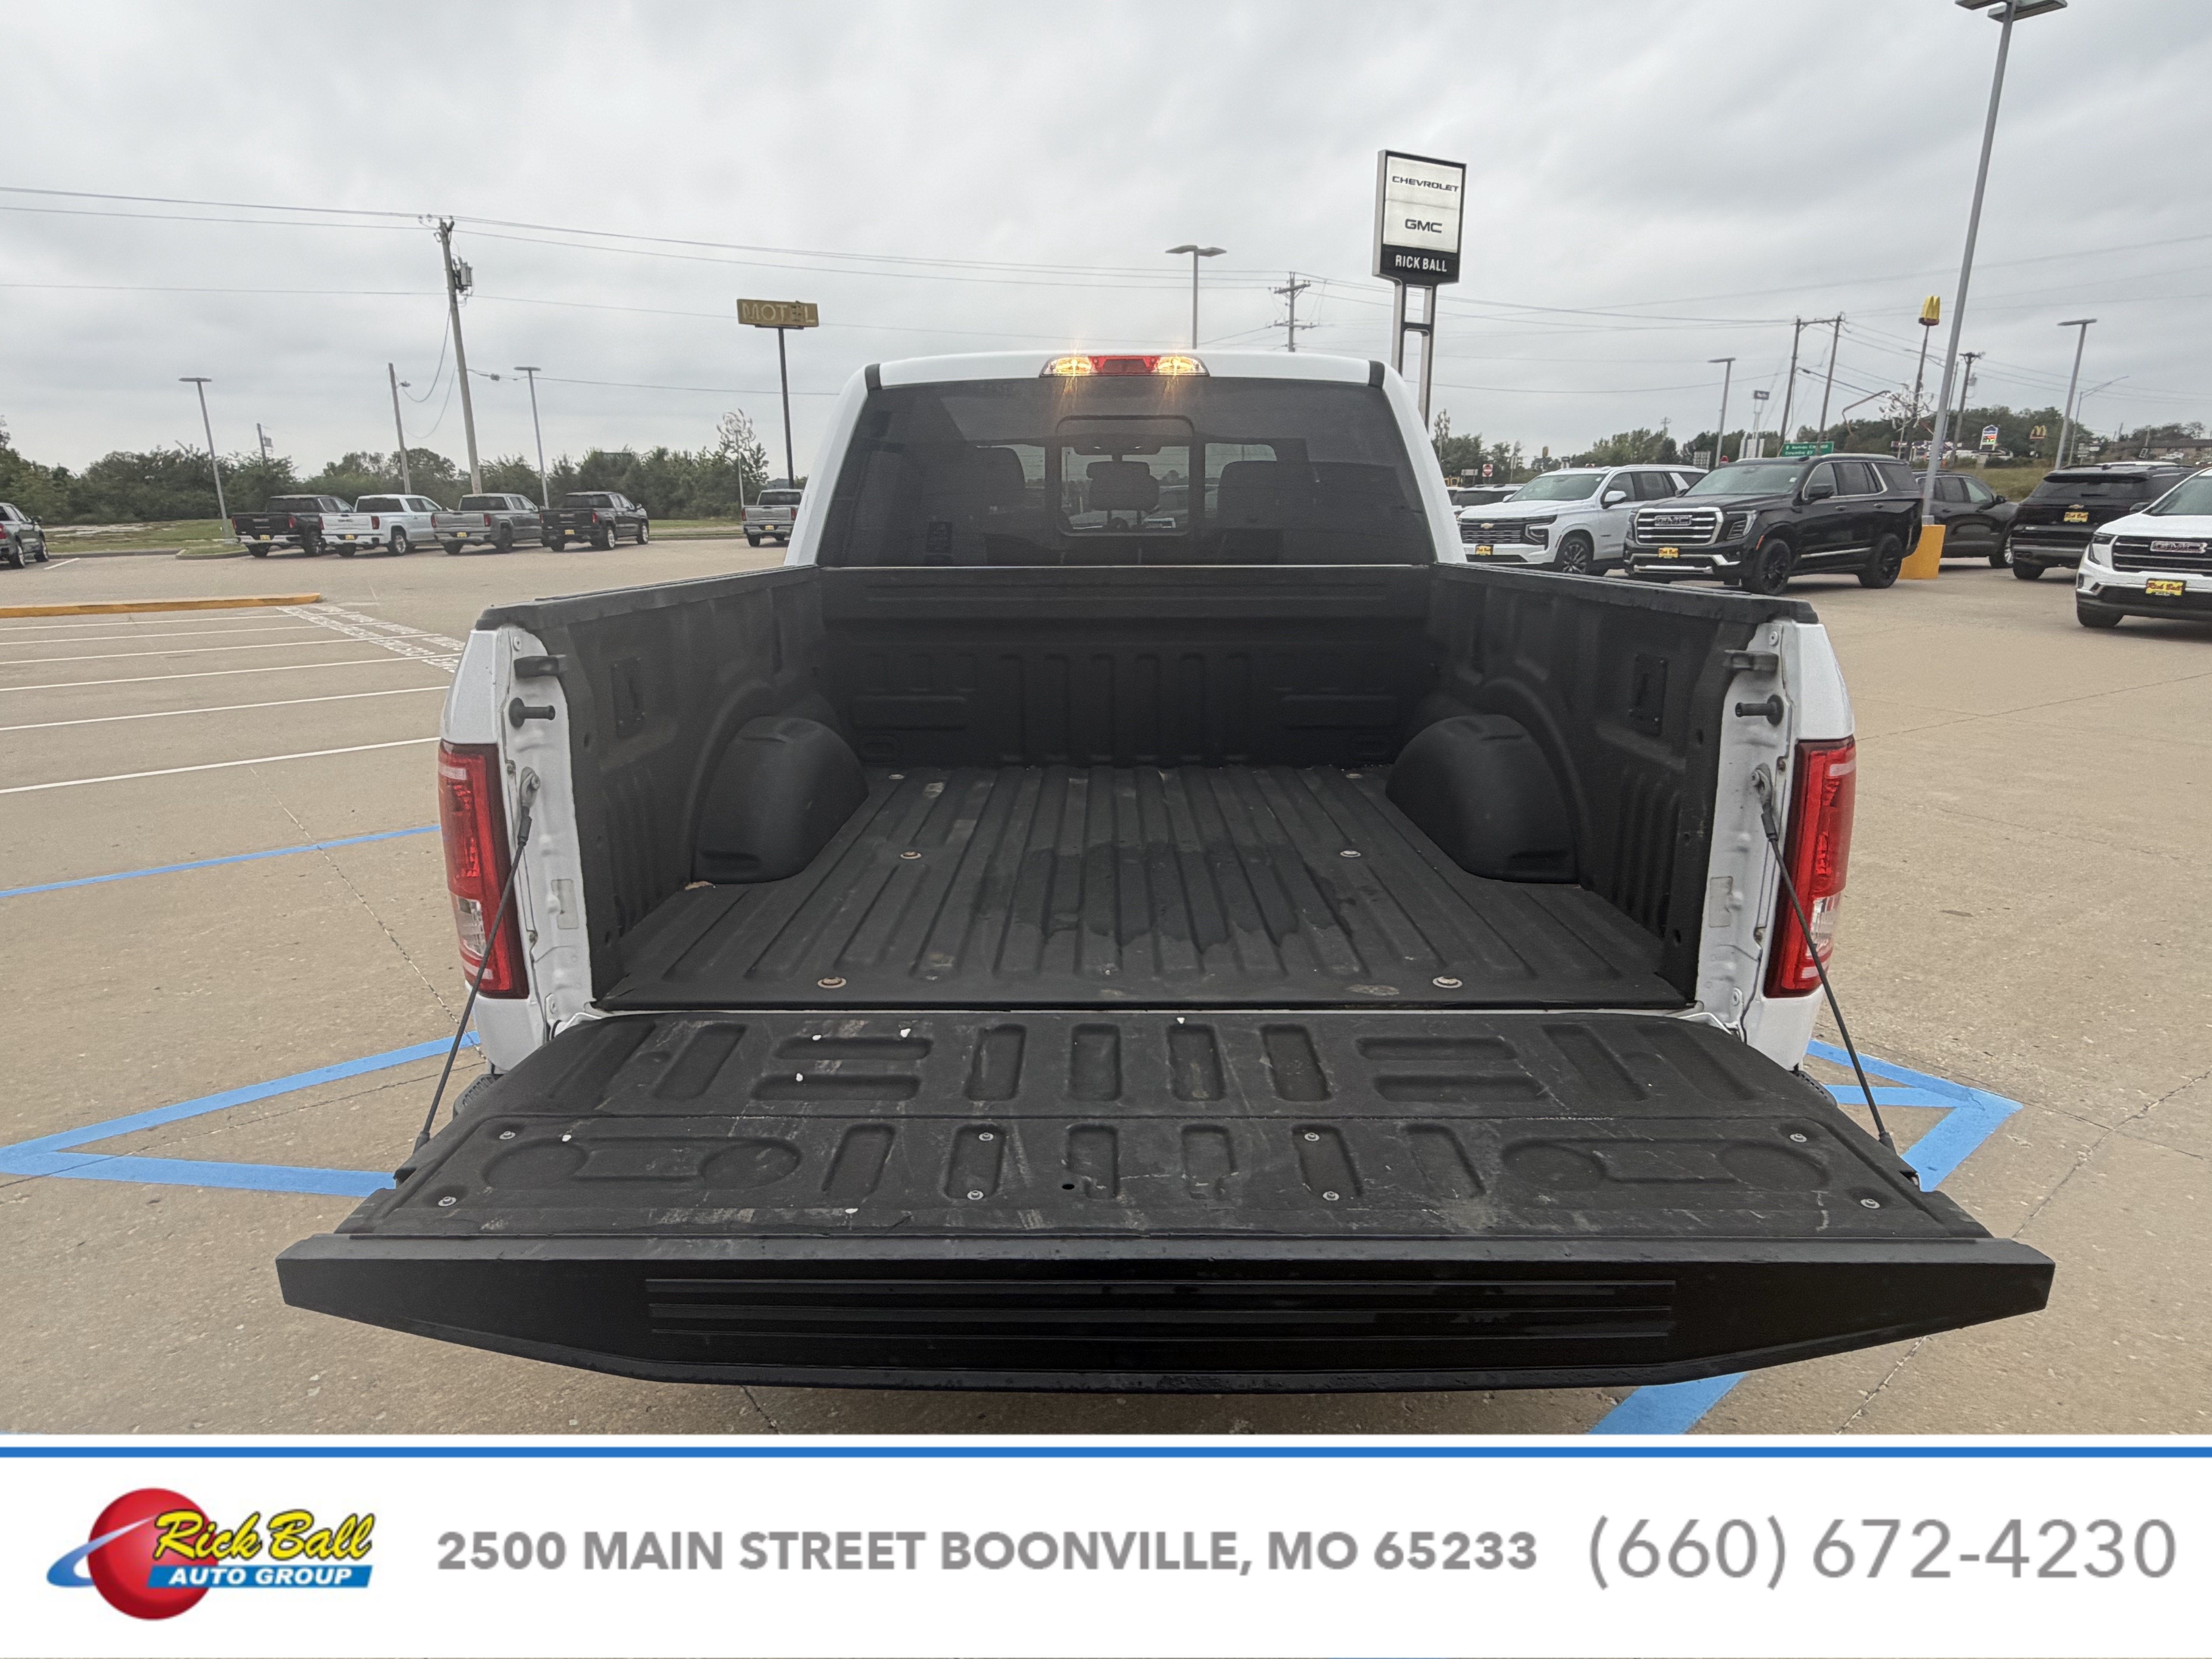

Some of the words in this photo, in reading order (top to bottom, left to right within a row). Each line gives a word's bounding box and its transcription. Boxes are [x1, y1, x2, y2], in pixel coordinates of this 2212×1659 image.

[1392, 175, 1459, 192] CHEVROLET
[1405, 218, 1443, 233] GMC
[1395, 254, 1420, 269] RICK
[1422, 258, 1448, 272] BALL
